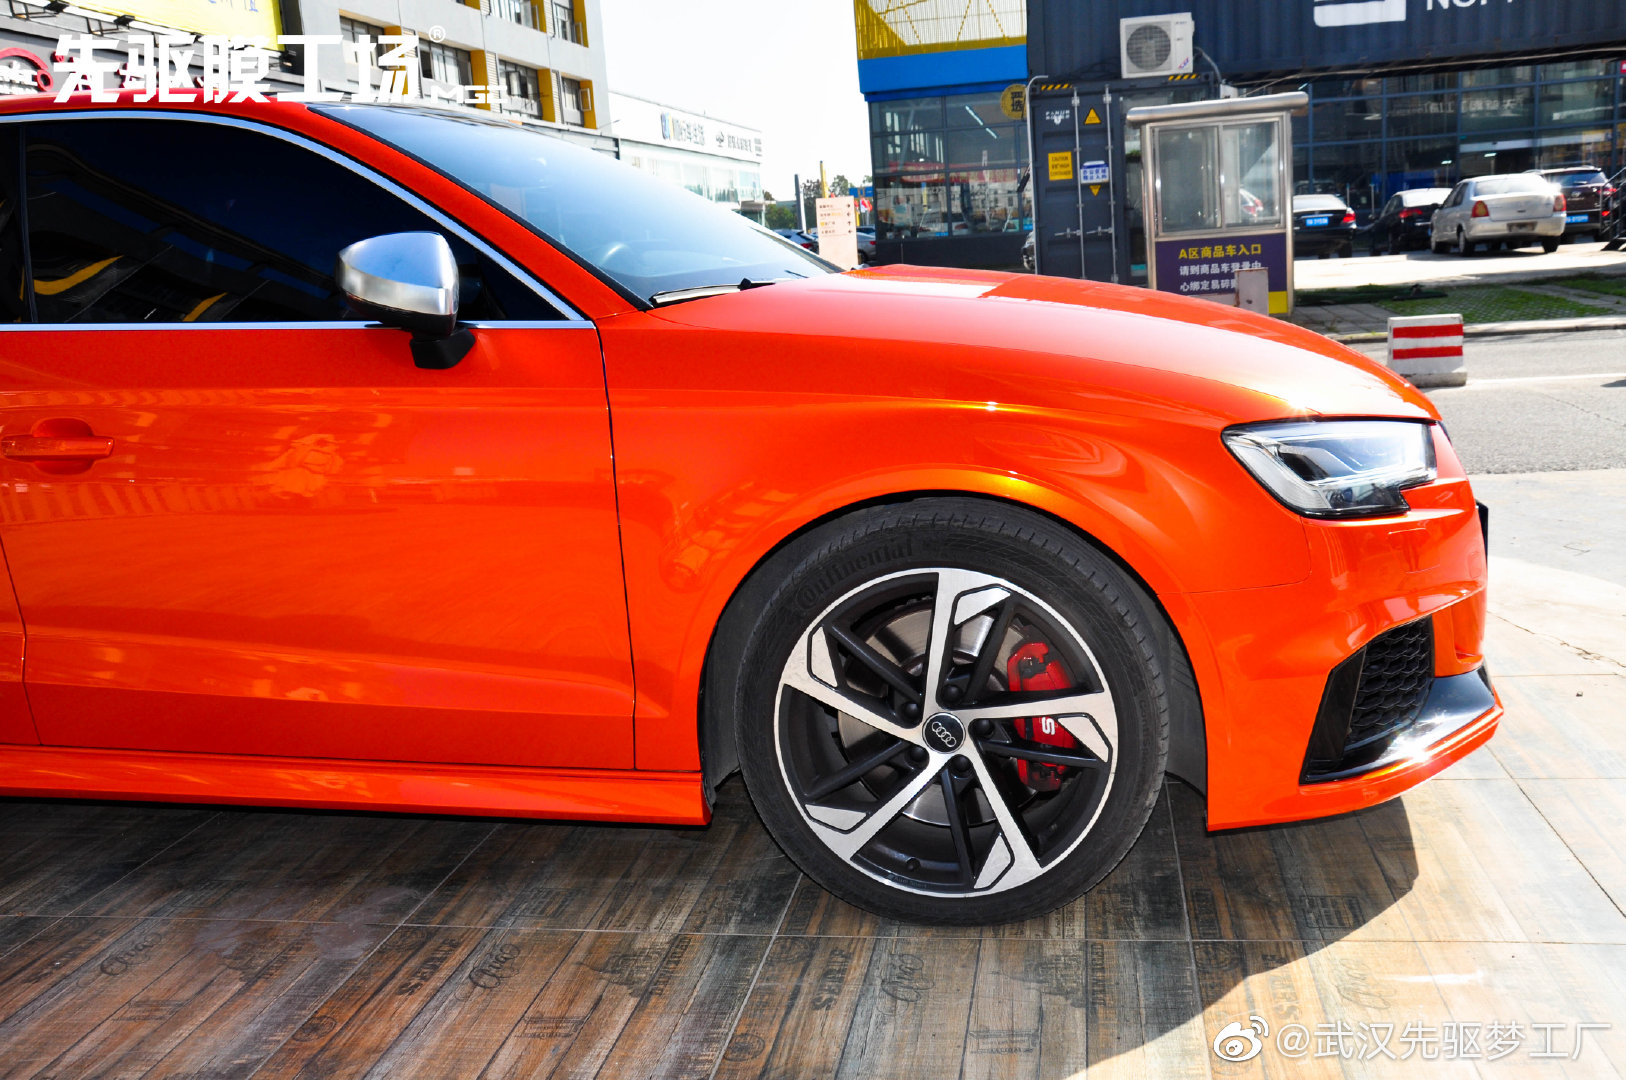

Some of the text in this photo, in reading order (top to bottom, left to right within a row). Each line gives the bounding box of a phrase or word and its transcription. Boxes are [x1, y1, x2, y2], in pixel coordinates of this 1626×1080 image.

[1178, 243, 1262, 260] A区商品车入口
